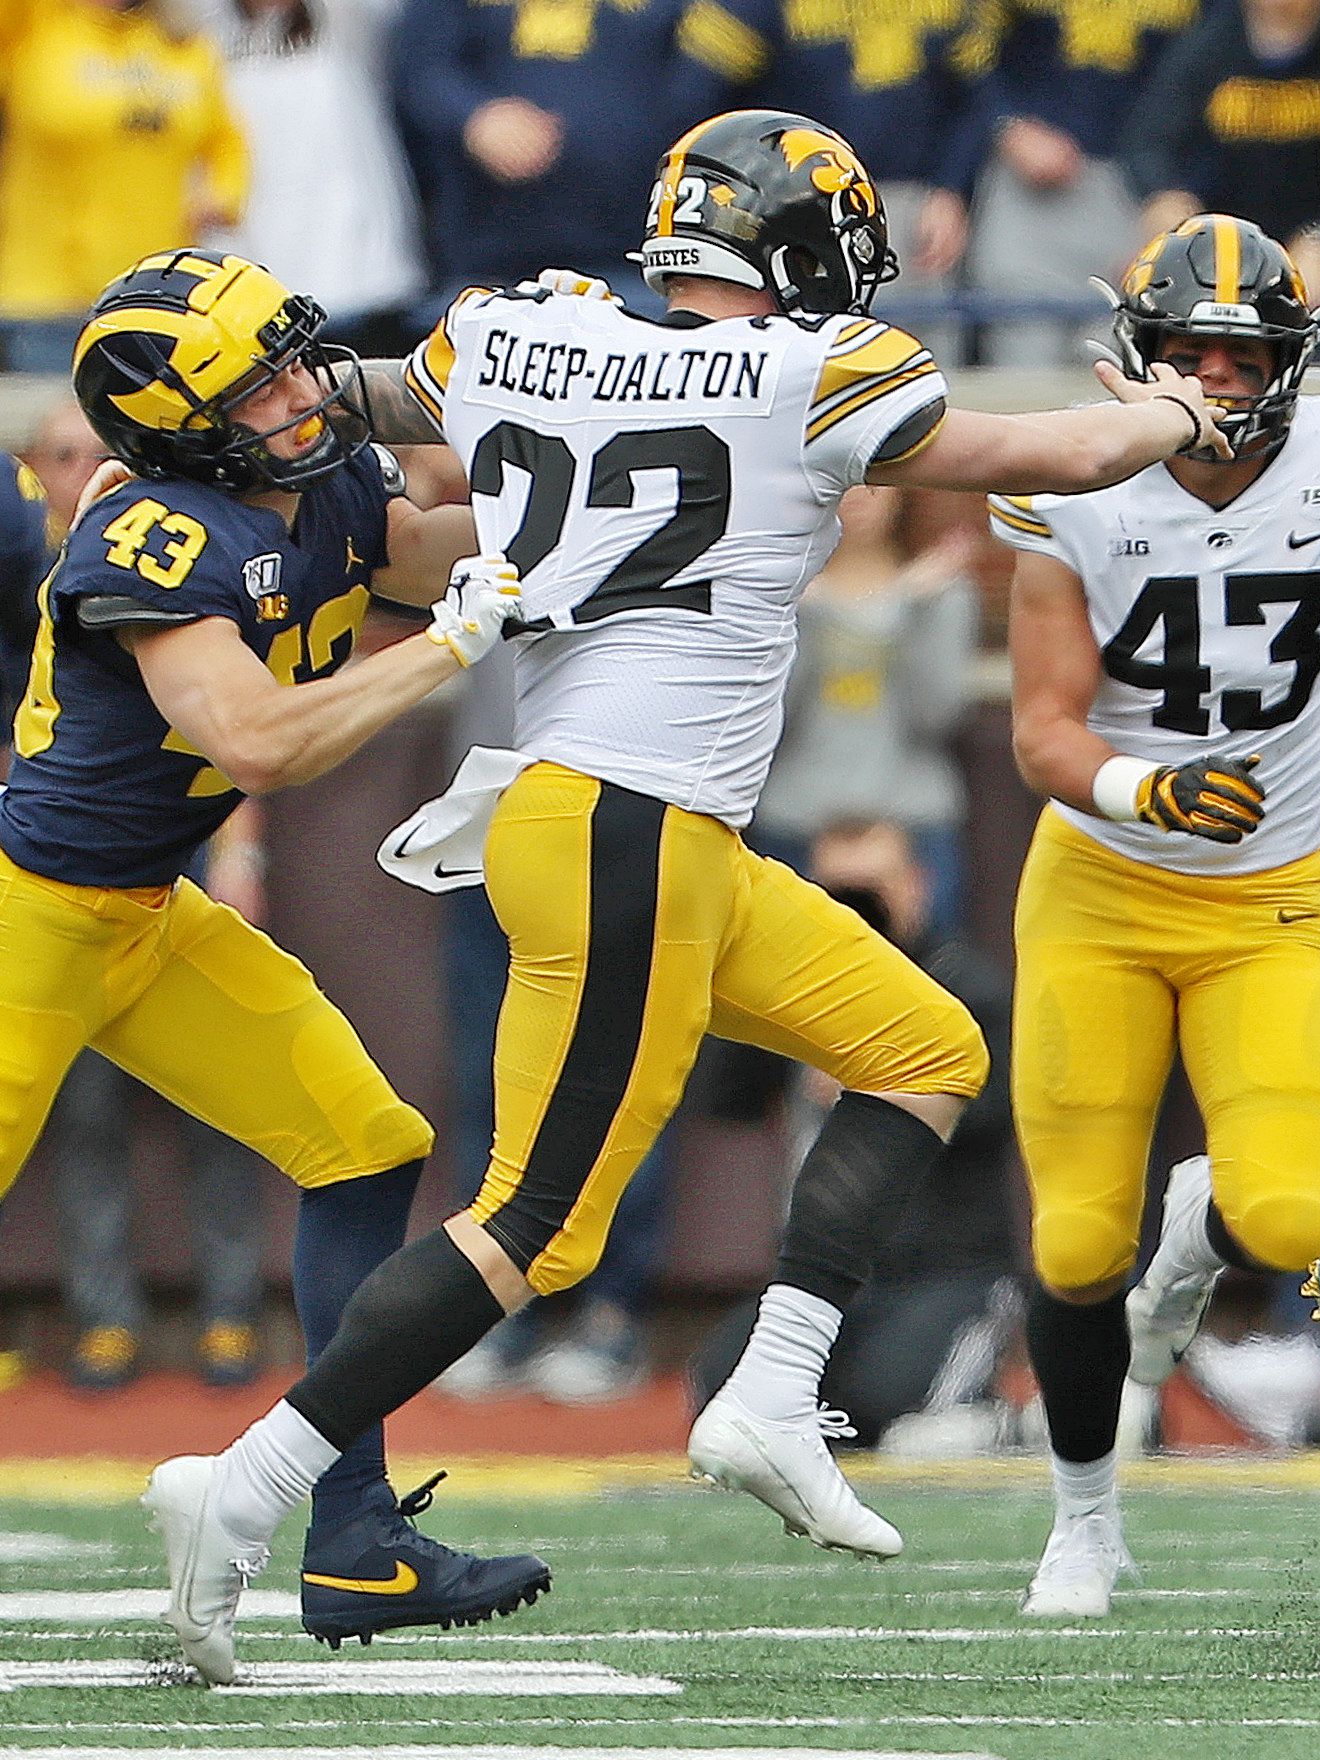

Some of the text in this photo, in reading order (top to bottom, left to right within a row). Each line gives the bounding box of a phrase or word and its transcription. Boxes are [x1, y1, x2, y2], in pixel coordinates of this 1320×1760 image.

[478, 328, 768, 401] SLEEP-DALTON
[102, 497, 211, 590] 43
[470, 418, 732, 640] 22
